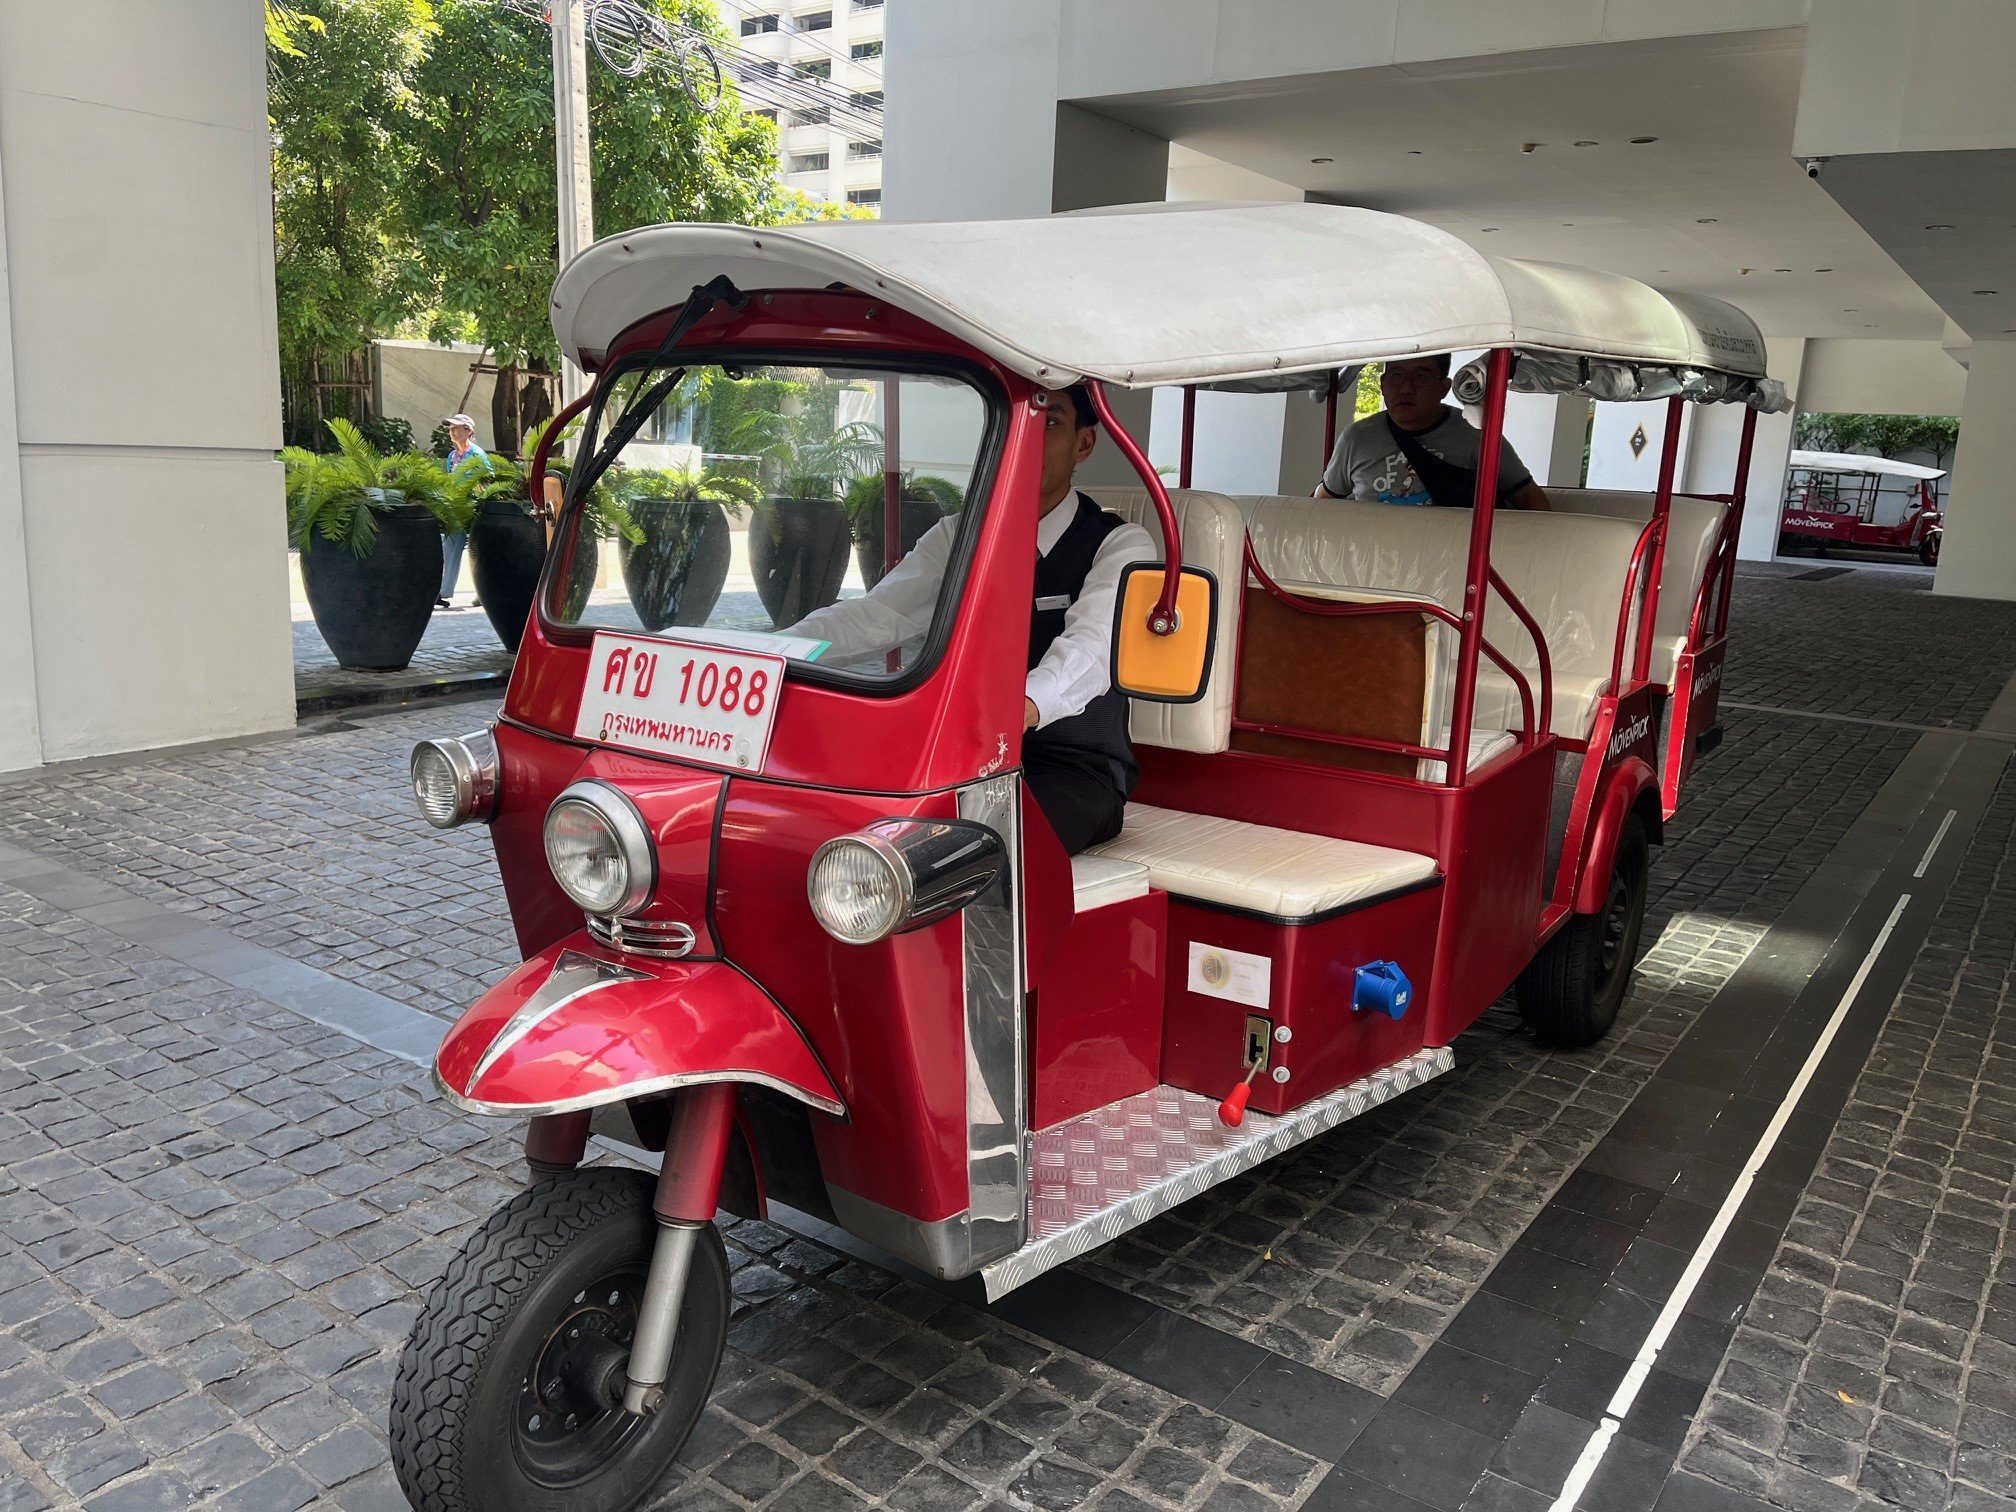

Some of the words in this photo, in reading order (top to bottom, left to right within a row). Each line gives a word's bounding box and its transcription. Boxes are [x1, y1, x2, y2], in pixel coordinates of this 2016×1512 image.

[1372, 471, 1398, 492] OF
[1785, 517, 1834, 531] MÖVENPICK
[603, 646, 658, 698] ศข
[679, 658, 768, 717] 1088
[602, 711, 734, 752] กรุงเทพมหานคร
[1607, 715, 1650, 761] MÖVENPICK
